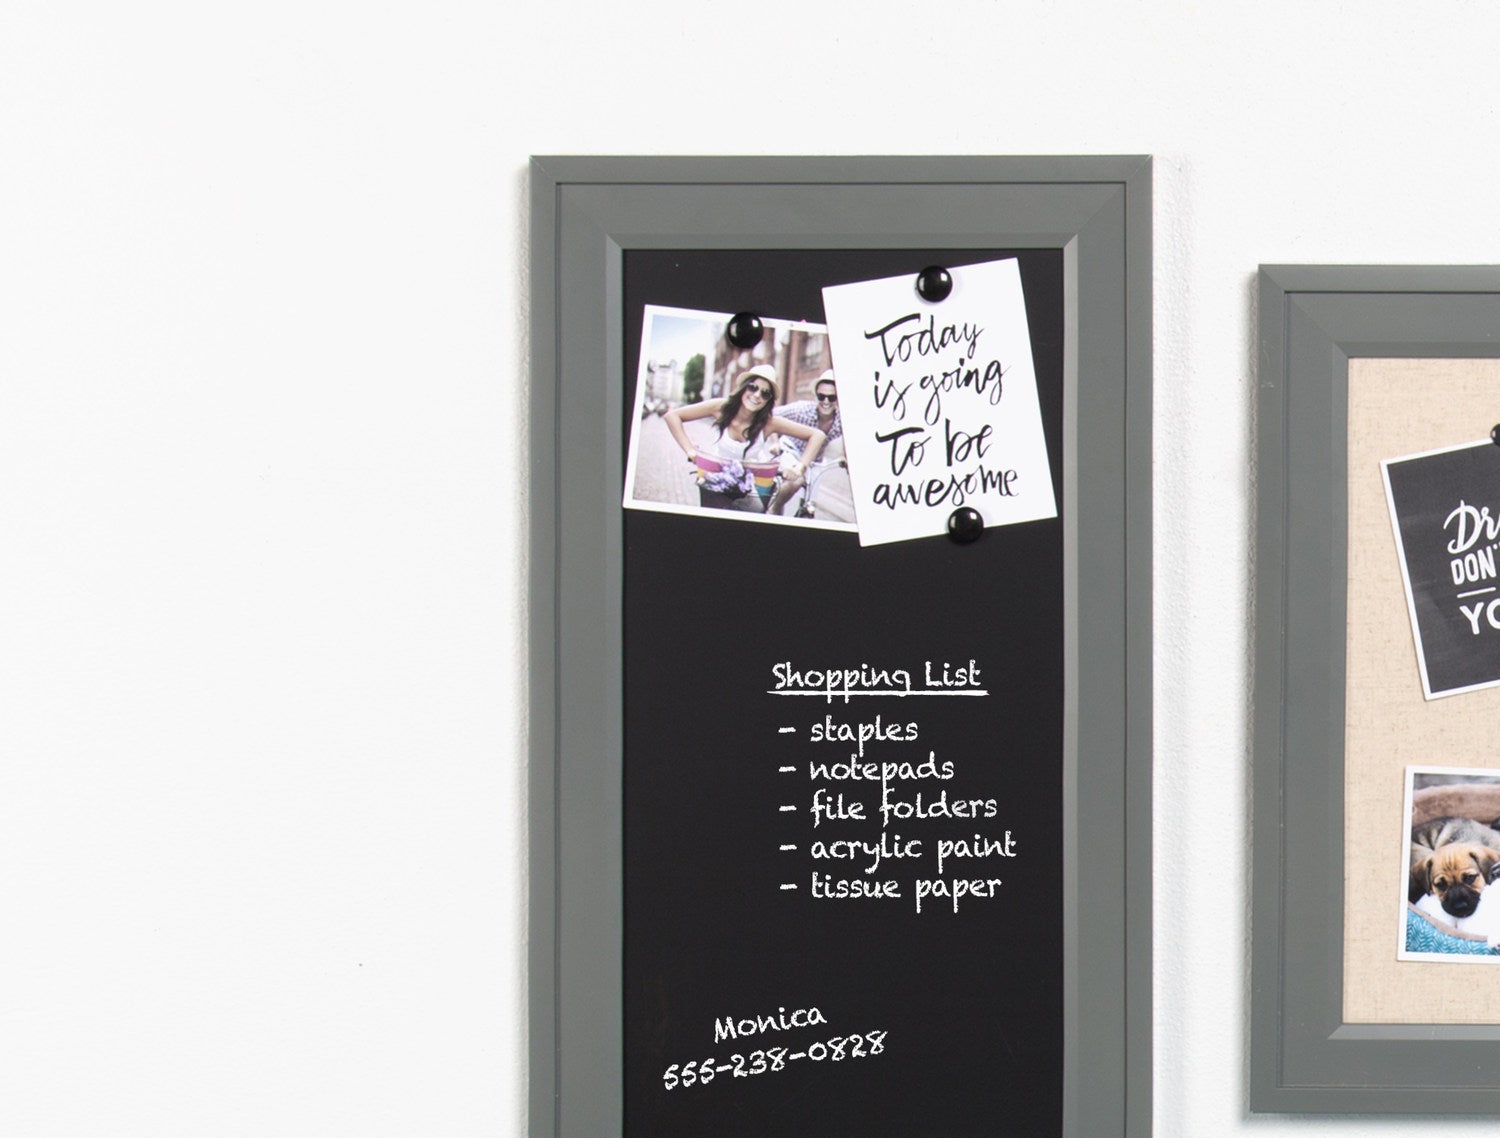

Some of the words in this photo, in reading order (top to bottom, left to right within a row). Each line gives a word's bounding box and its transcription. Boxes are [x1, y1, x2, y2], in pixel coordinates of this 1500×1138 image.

[864, 312, 984, 367] Today
[874, 371, 912, 420] is
[920, 357, 1010, 426] going
[945, 418, 993, 467] be
[873, 464, 1019, 510] awesome
[772, 661, 911, 703] Shopping
[924, 659, 981, 688] List
[810, 714, 918, 757] staples
[810, 751, 954, 790] notepads
[809, 788, 866, 828] file
[879, 788, 998, 828] folders
[810, 832, 923, 874] acrylic
[937, 831, 1017, 873] paint
[811, 871, 901, 898] tissue
[915, 877, 1003, 914] paper
[713, 1006, 828, 1043] Monica
[662, 1030, 888, 1090] 555-238-0828
